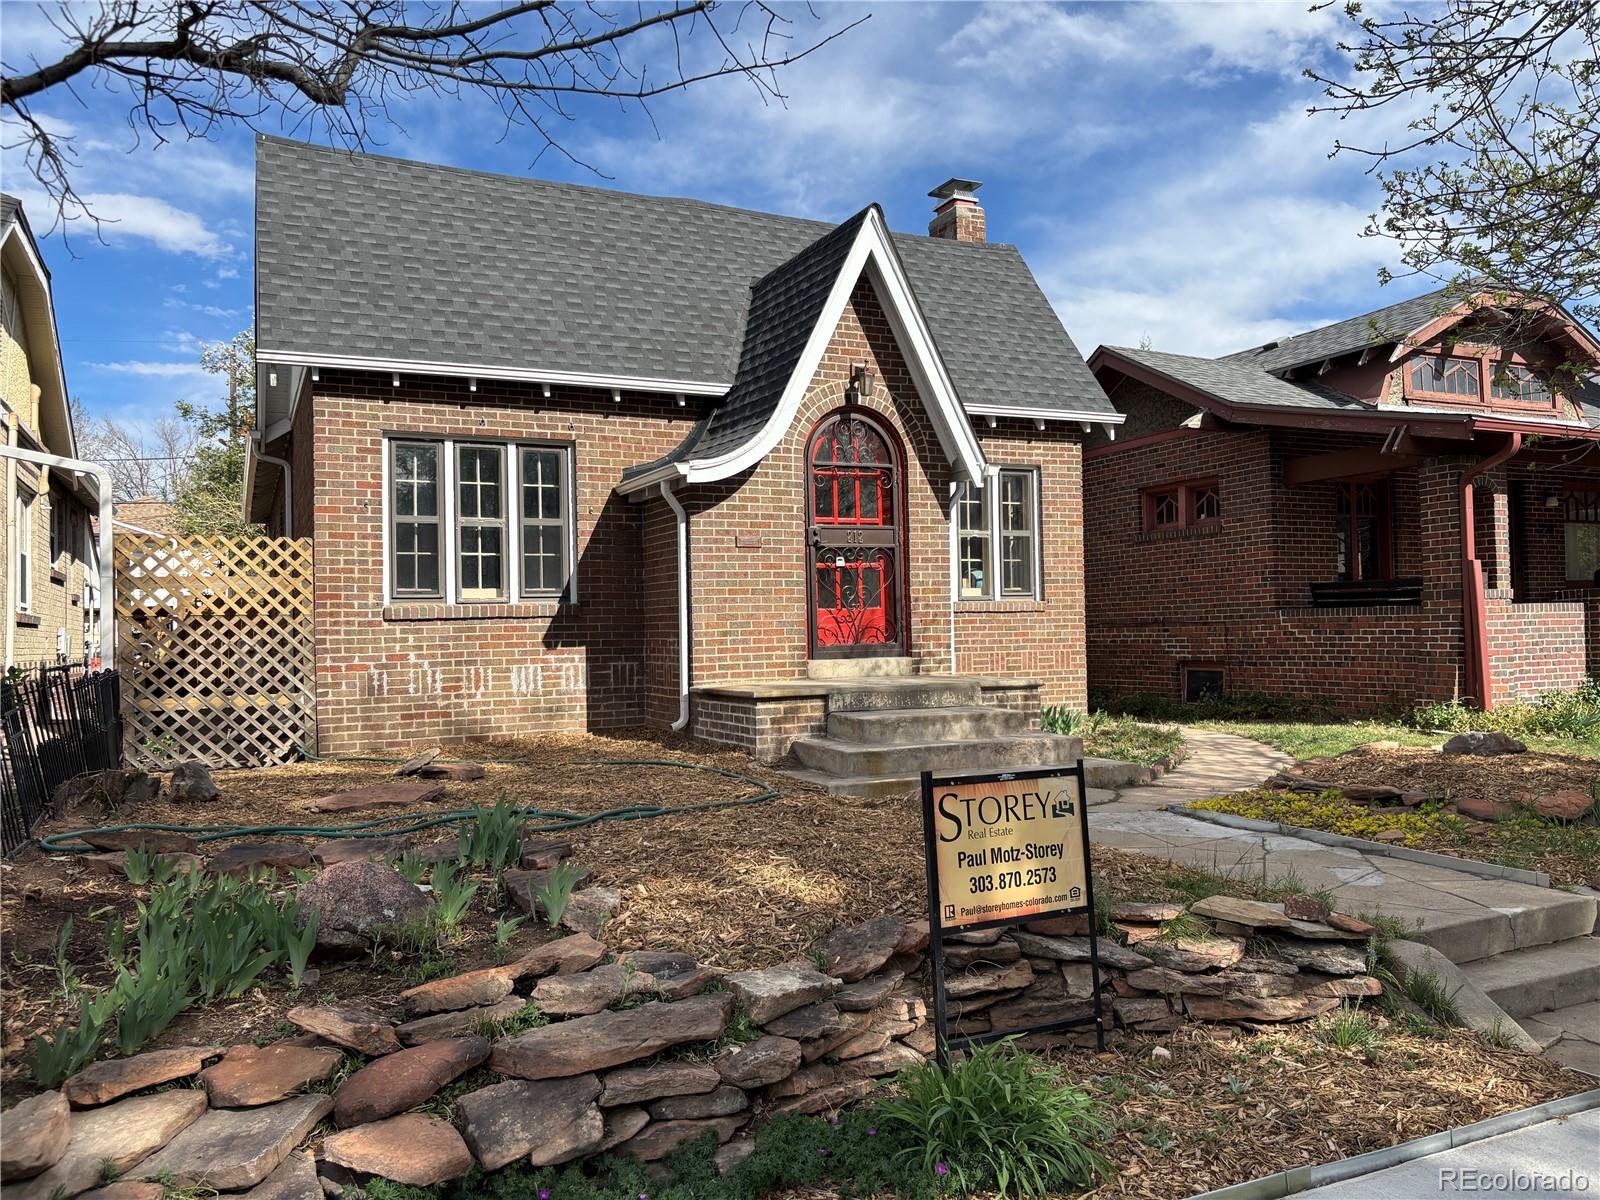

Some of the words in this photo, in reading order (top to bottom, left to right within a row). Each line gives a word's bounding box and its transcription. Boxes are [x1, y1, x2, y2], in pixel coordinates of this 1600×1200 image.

[847, 530, 863, 543] 212
[939, 791, 1051, 842] STOREY
[968, 829, 987, 839] Real
[989, 827, 1014, 838] Estate
[958, 850, 987, 868] Paul
[991, 843, 1063, 865] Motz-Storey
[969, 867, 1057, 893] 303.870.2573
[961, 893, 1068, 916] Paul@storeyhomes-colorado.com
